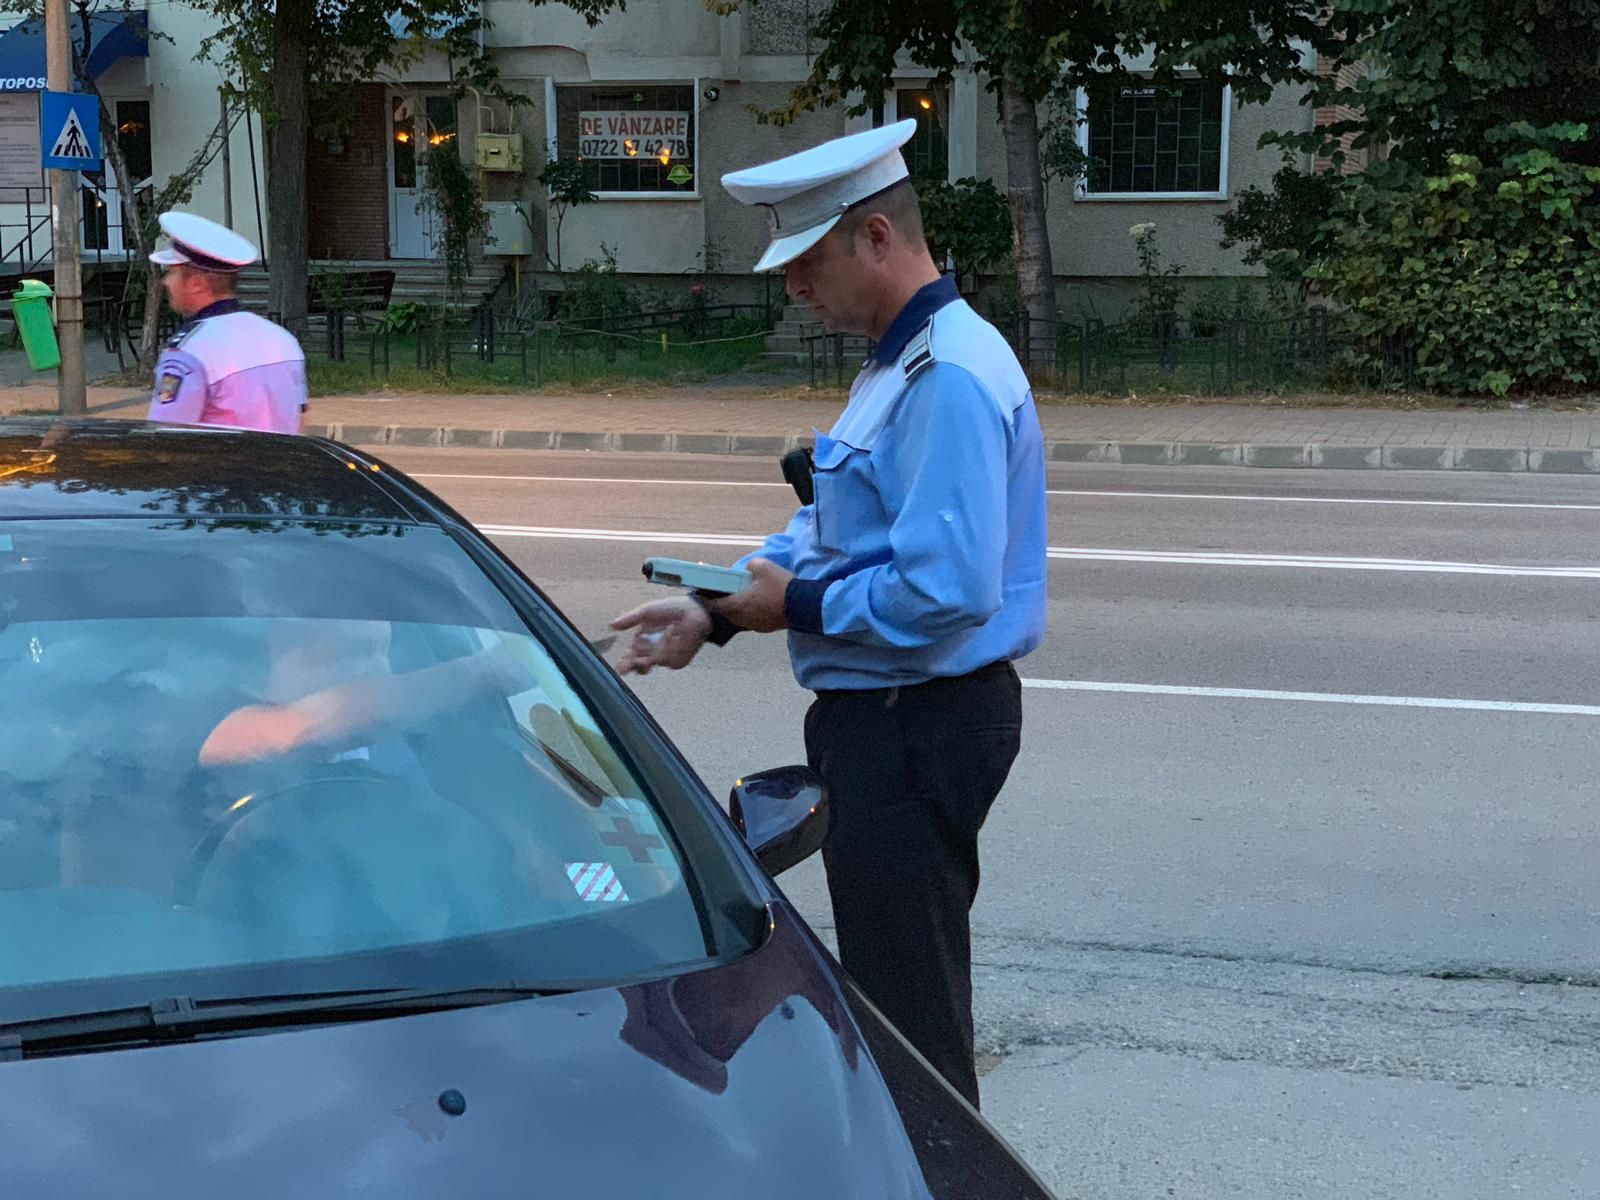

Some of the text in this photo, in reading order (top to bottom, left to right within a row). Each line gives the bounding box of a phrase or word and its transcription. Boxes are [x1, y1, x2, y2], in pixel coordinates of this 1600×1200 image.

[581, 113, 685, 135] DE VÂNZARE
[582, 139, 618, 156] 0722
[644, 139, 664, 156] 42
[667, 139, 686, 156] 78
